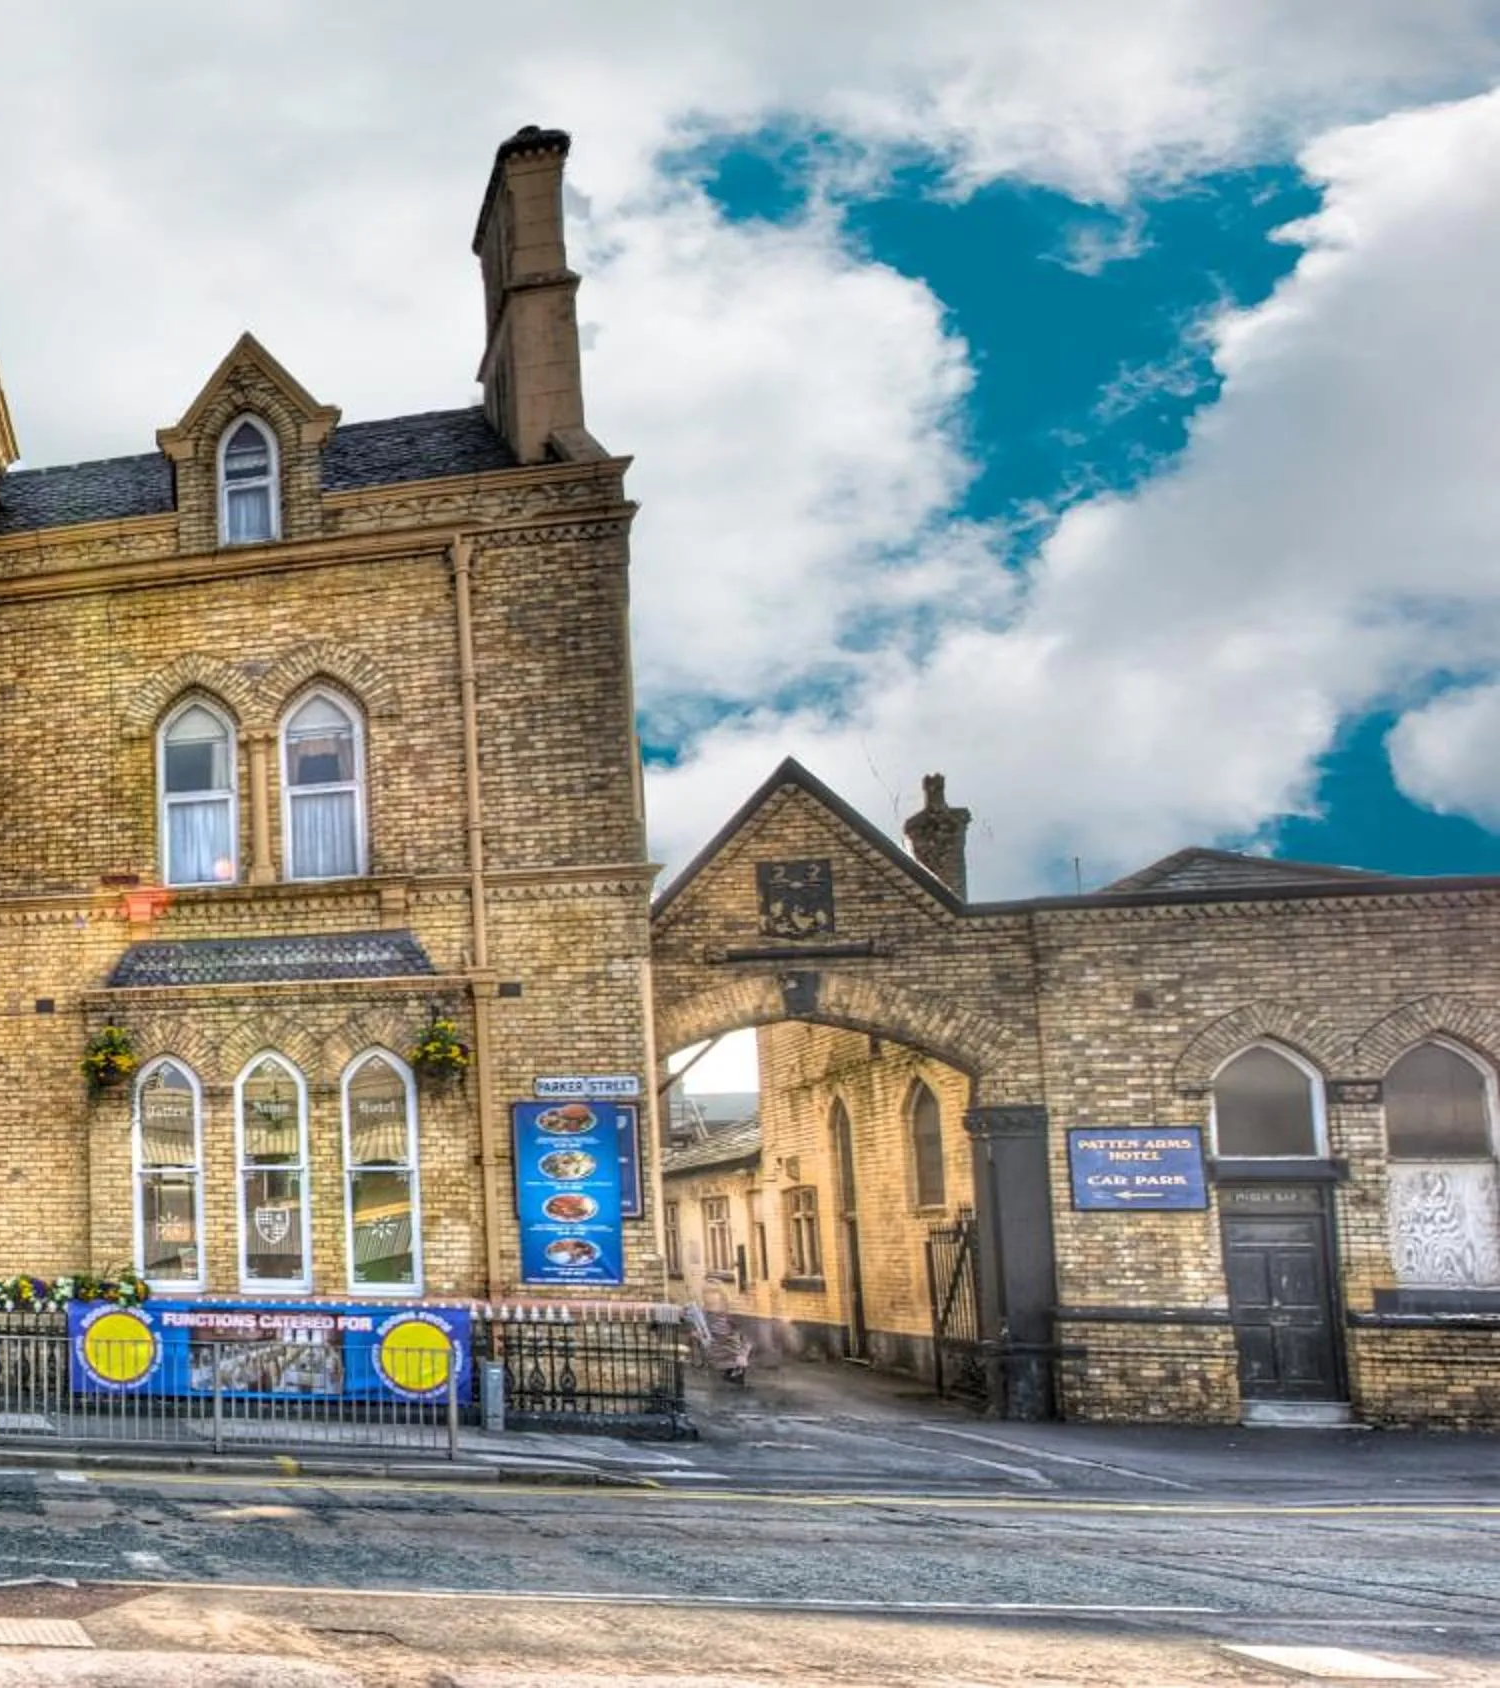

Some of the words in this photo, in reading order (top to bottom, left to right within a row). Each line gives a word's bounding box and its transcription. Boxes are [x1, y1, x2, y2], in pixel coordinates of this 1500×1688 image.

[538, 1081, 583, 1092] PARKER
[590, 1080, 636, 1092] STREET
[1077, 1139, 1138, 1149] PATTEN
[1144, 1139, 1192, 1149] ARMS
[1109, 1151, 1163, 1161] HOTEL
[1087, 1175, 1128, 1185] CAR
[1135, 1175, 1188, 1185] PARK
[161, 1312, 256, 1328] FUNCTIONS
[259, 1313, 335, 1329] CATERED
[337, 1315, 373, 1331] FOR
